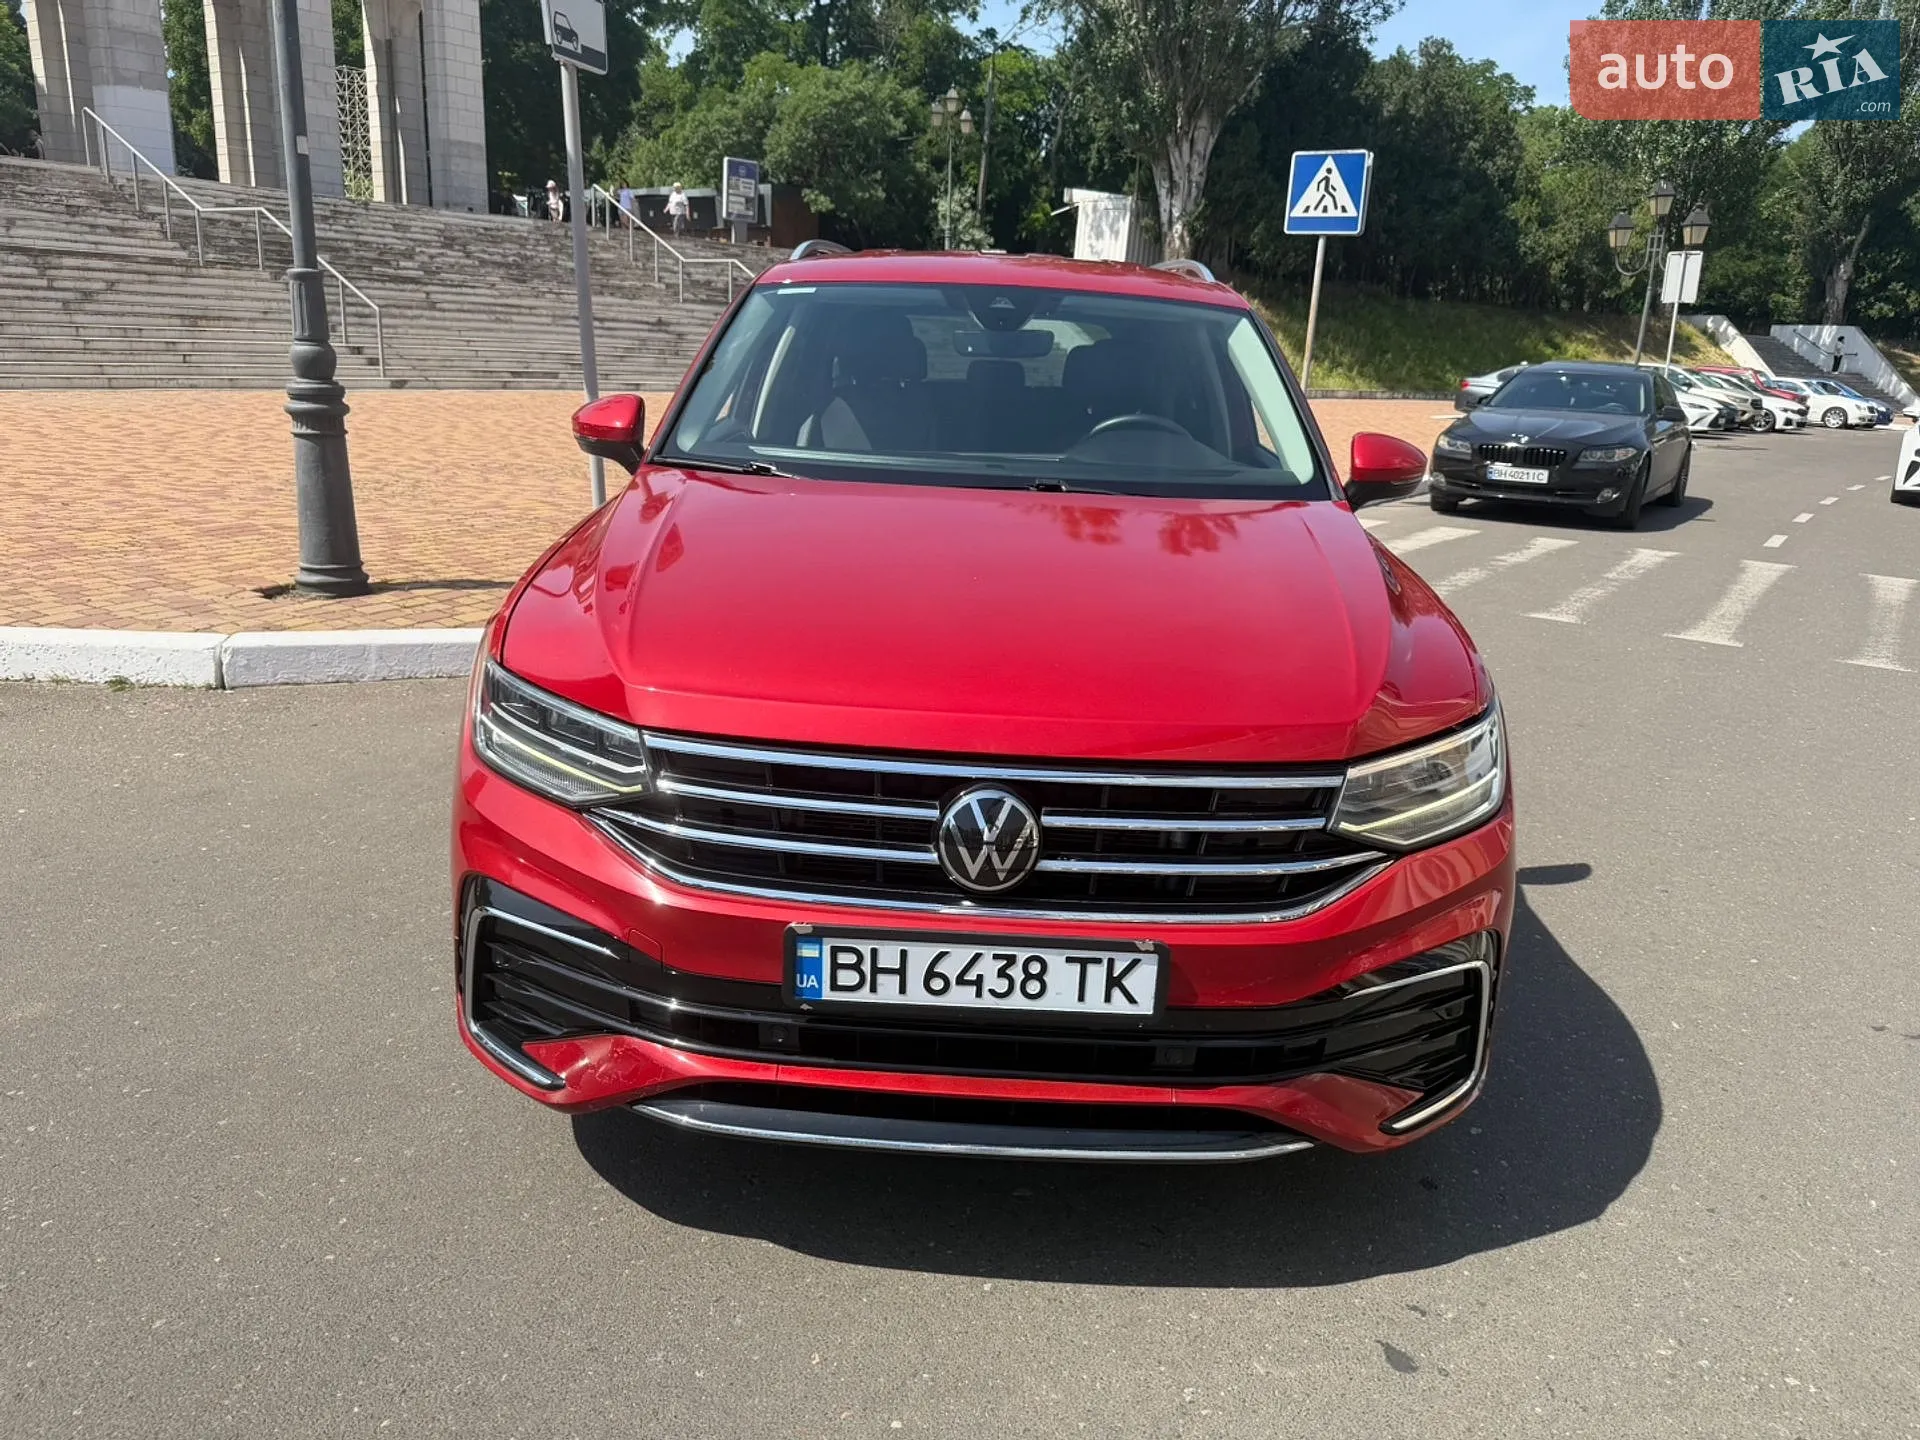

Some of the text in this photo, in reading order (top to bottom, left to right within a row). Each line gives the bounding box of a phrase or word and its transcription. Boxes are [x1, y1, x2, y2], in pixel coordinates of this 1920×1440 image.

[796, 973, 819, 989] UA
[829, 944, 1142, 1005] BH 6438 TK
